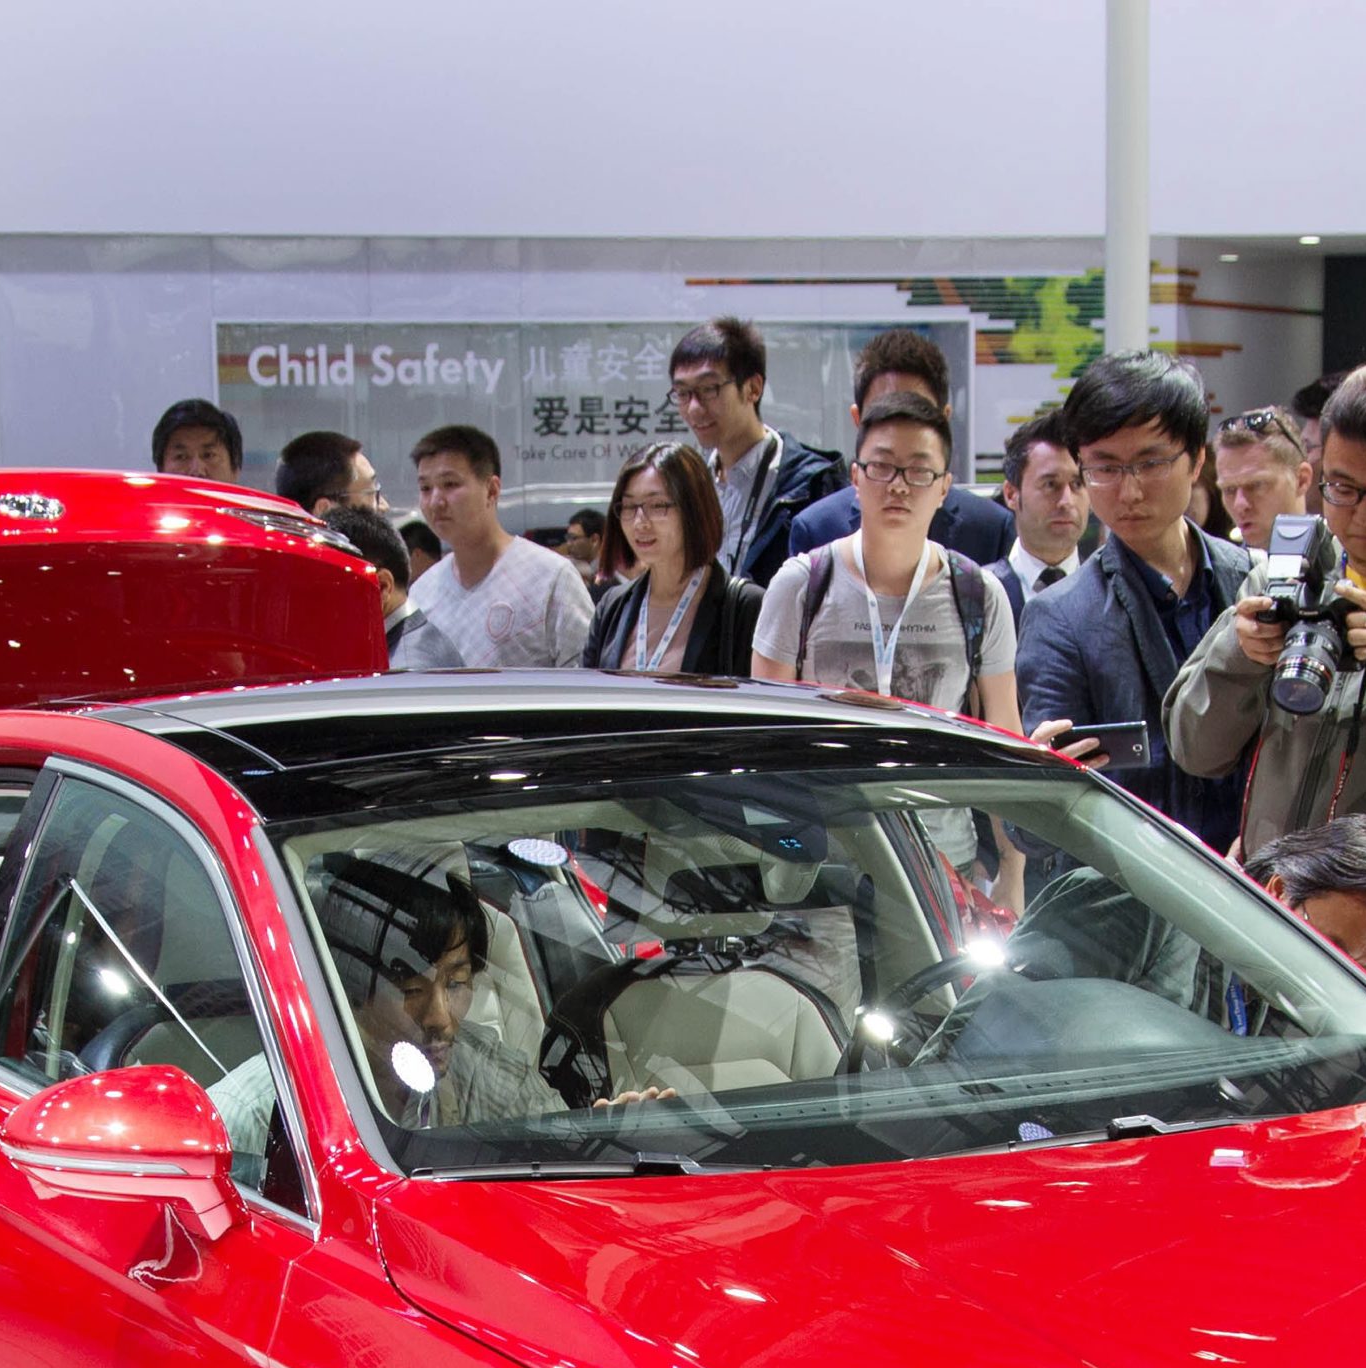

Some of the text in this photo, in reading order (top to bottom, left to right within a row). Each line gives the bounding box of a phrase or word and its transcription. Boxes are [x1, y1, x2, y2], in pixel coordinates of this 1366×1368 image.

[248, 343, 505, 394] Child Safety
[523, 343, 666, 382] 儿童安全
[515, 446, 546, 460] Take
[552, 445, 587, 460] Care
